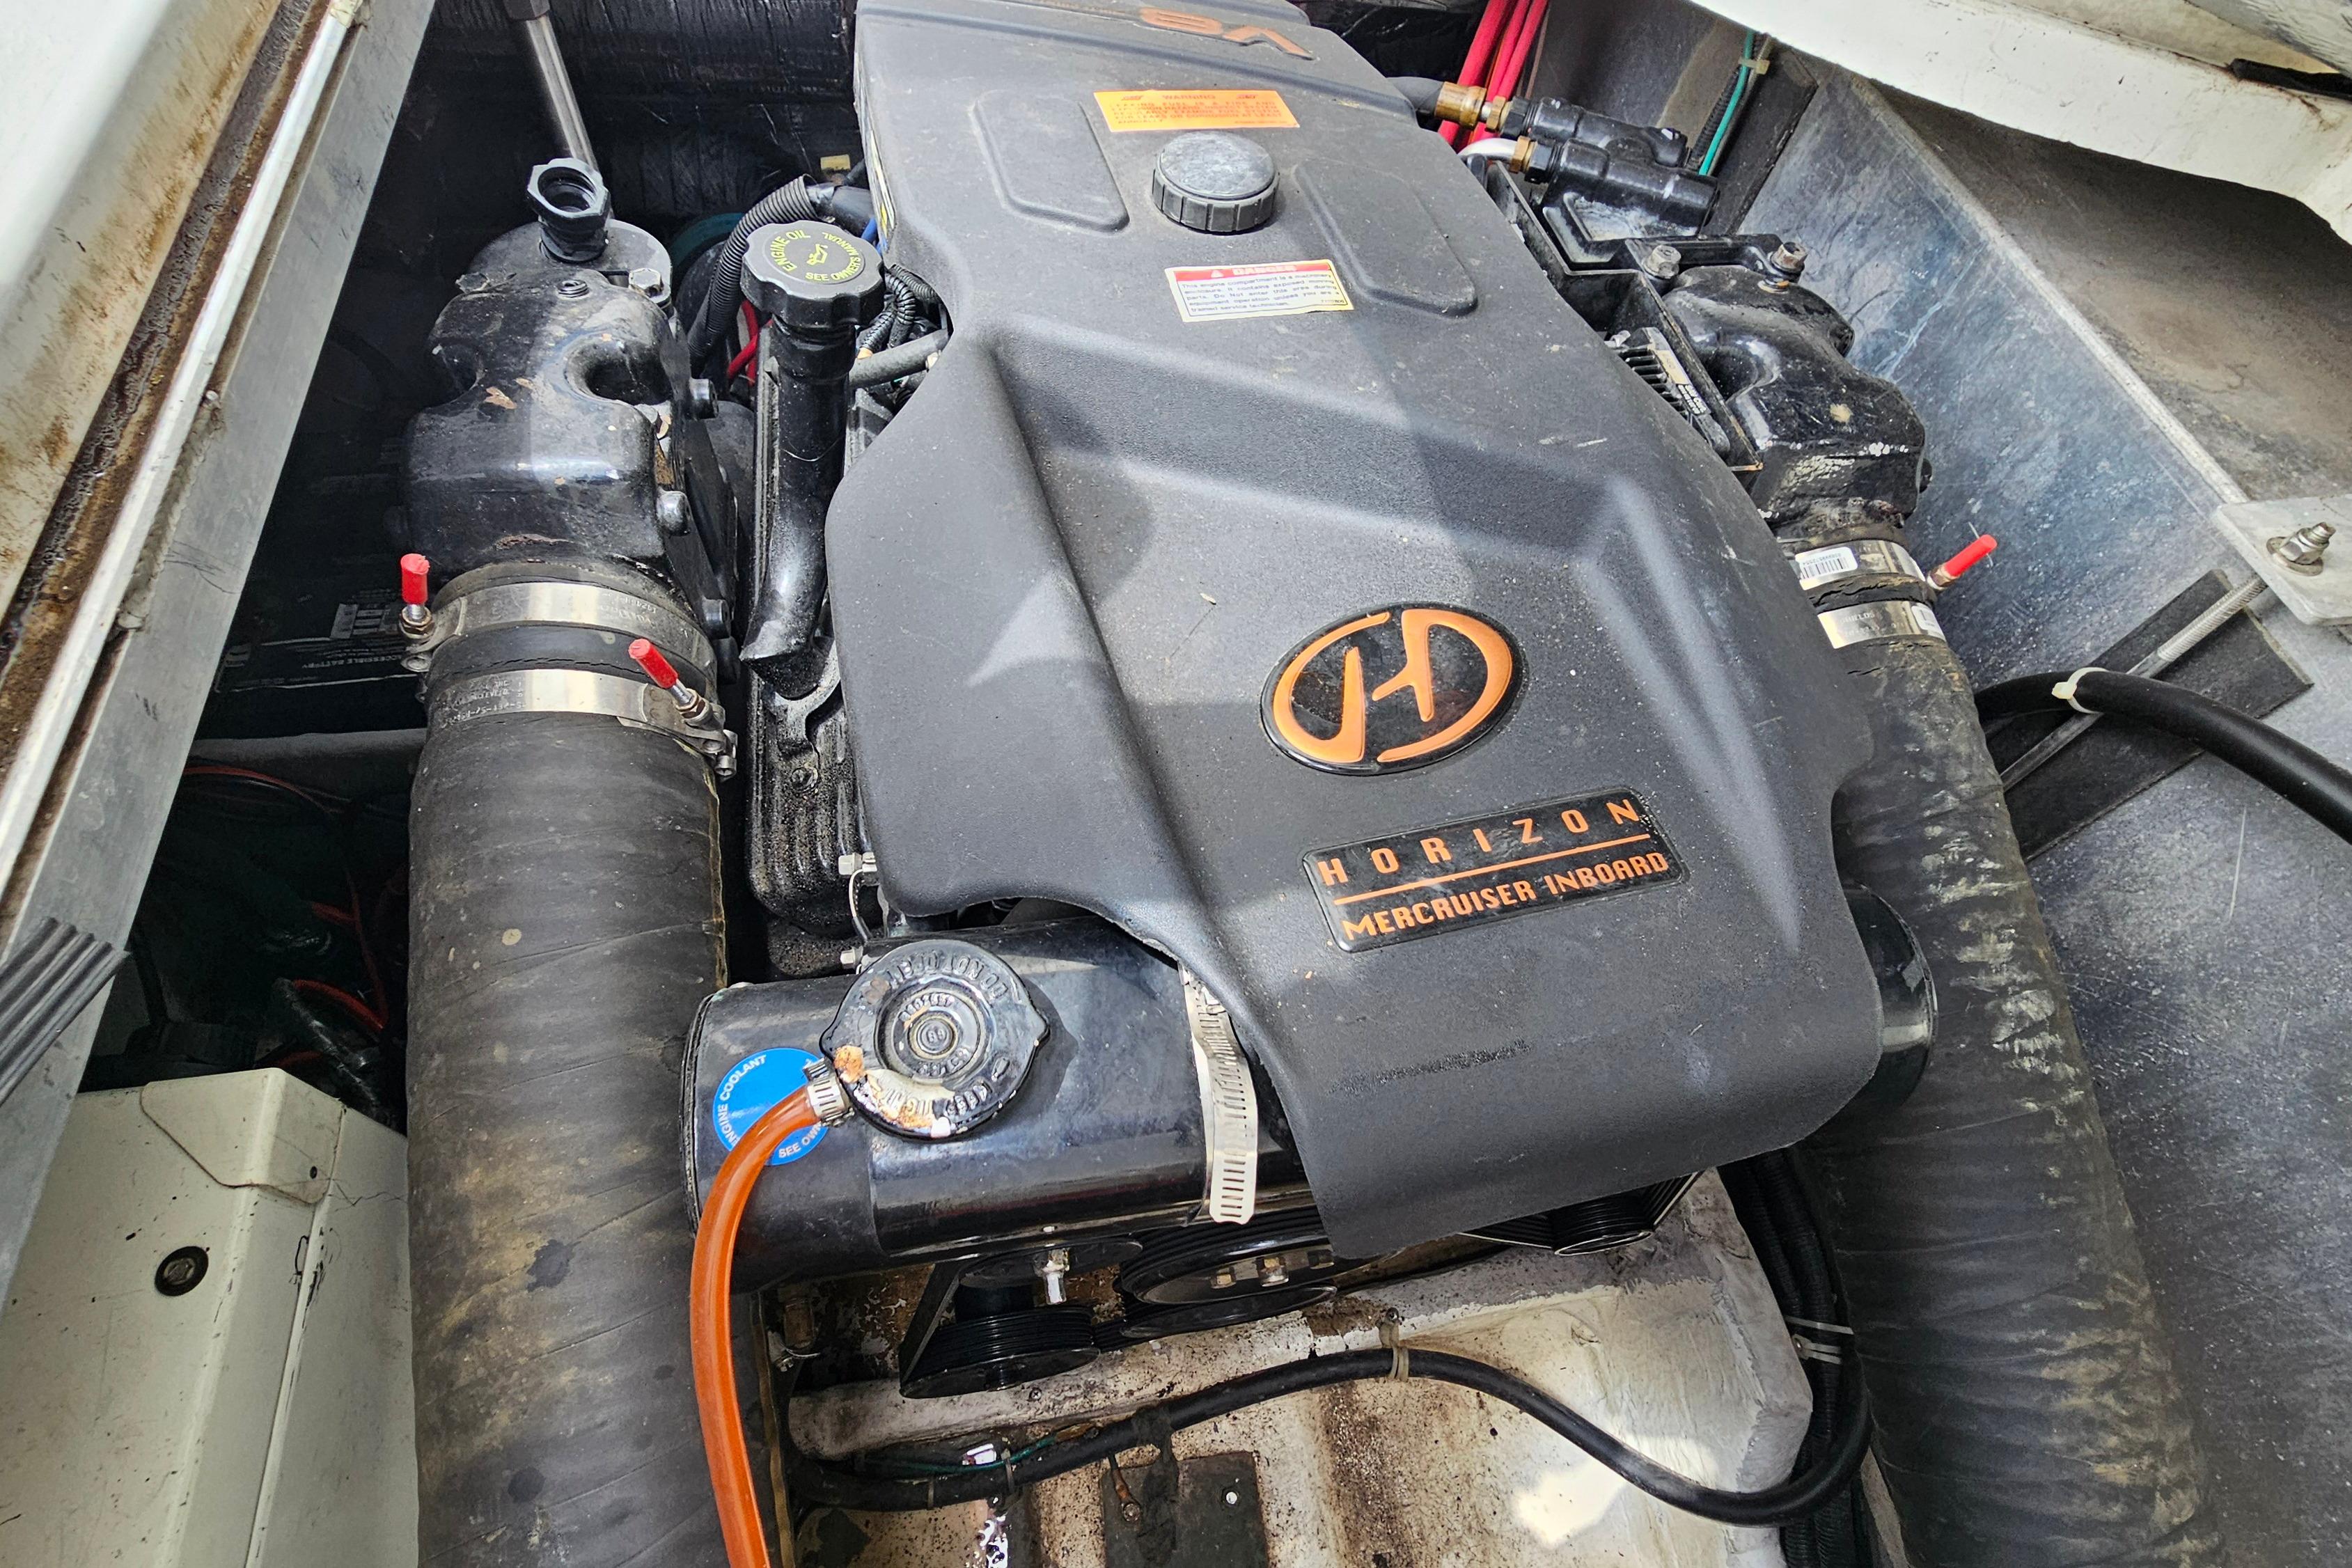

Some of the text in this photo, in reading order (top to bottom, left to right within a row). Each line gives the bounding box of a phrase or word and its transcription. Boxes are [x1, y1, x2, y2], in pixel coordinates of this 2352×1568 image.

[770, 230, 811, 272] ENGINE OIL
[805, 272, 830, 281] SEE
[822, 231, 859, 256] MANUAL
[1231, 265, 1298, 275] DANGER
[1226, 277, 1278, 285] compartment
[1317, 798, 1642, 886] HORIZON
[1342, 852, 1669, 941] MERCRUISER INBOARD
[719, 1054, 767, 1101] COOLANT
[778, 1142, 802, 1159] SEE
